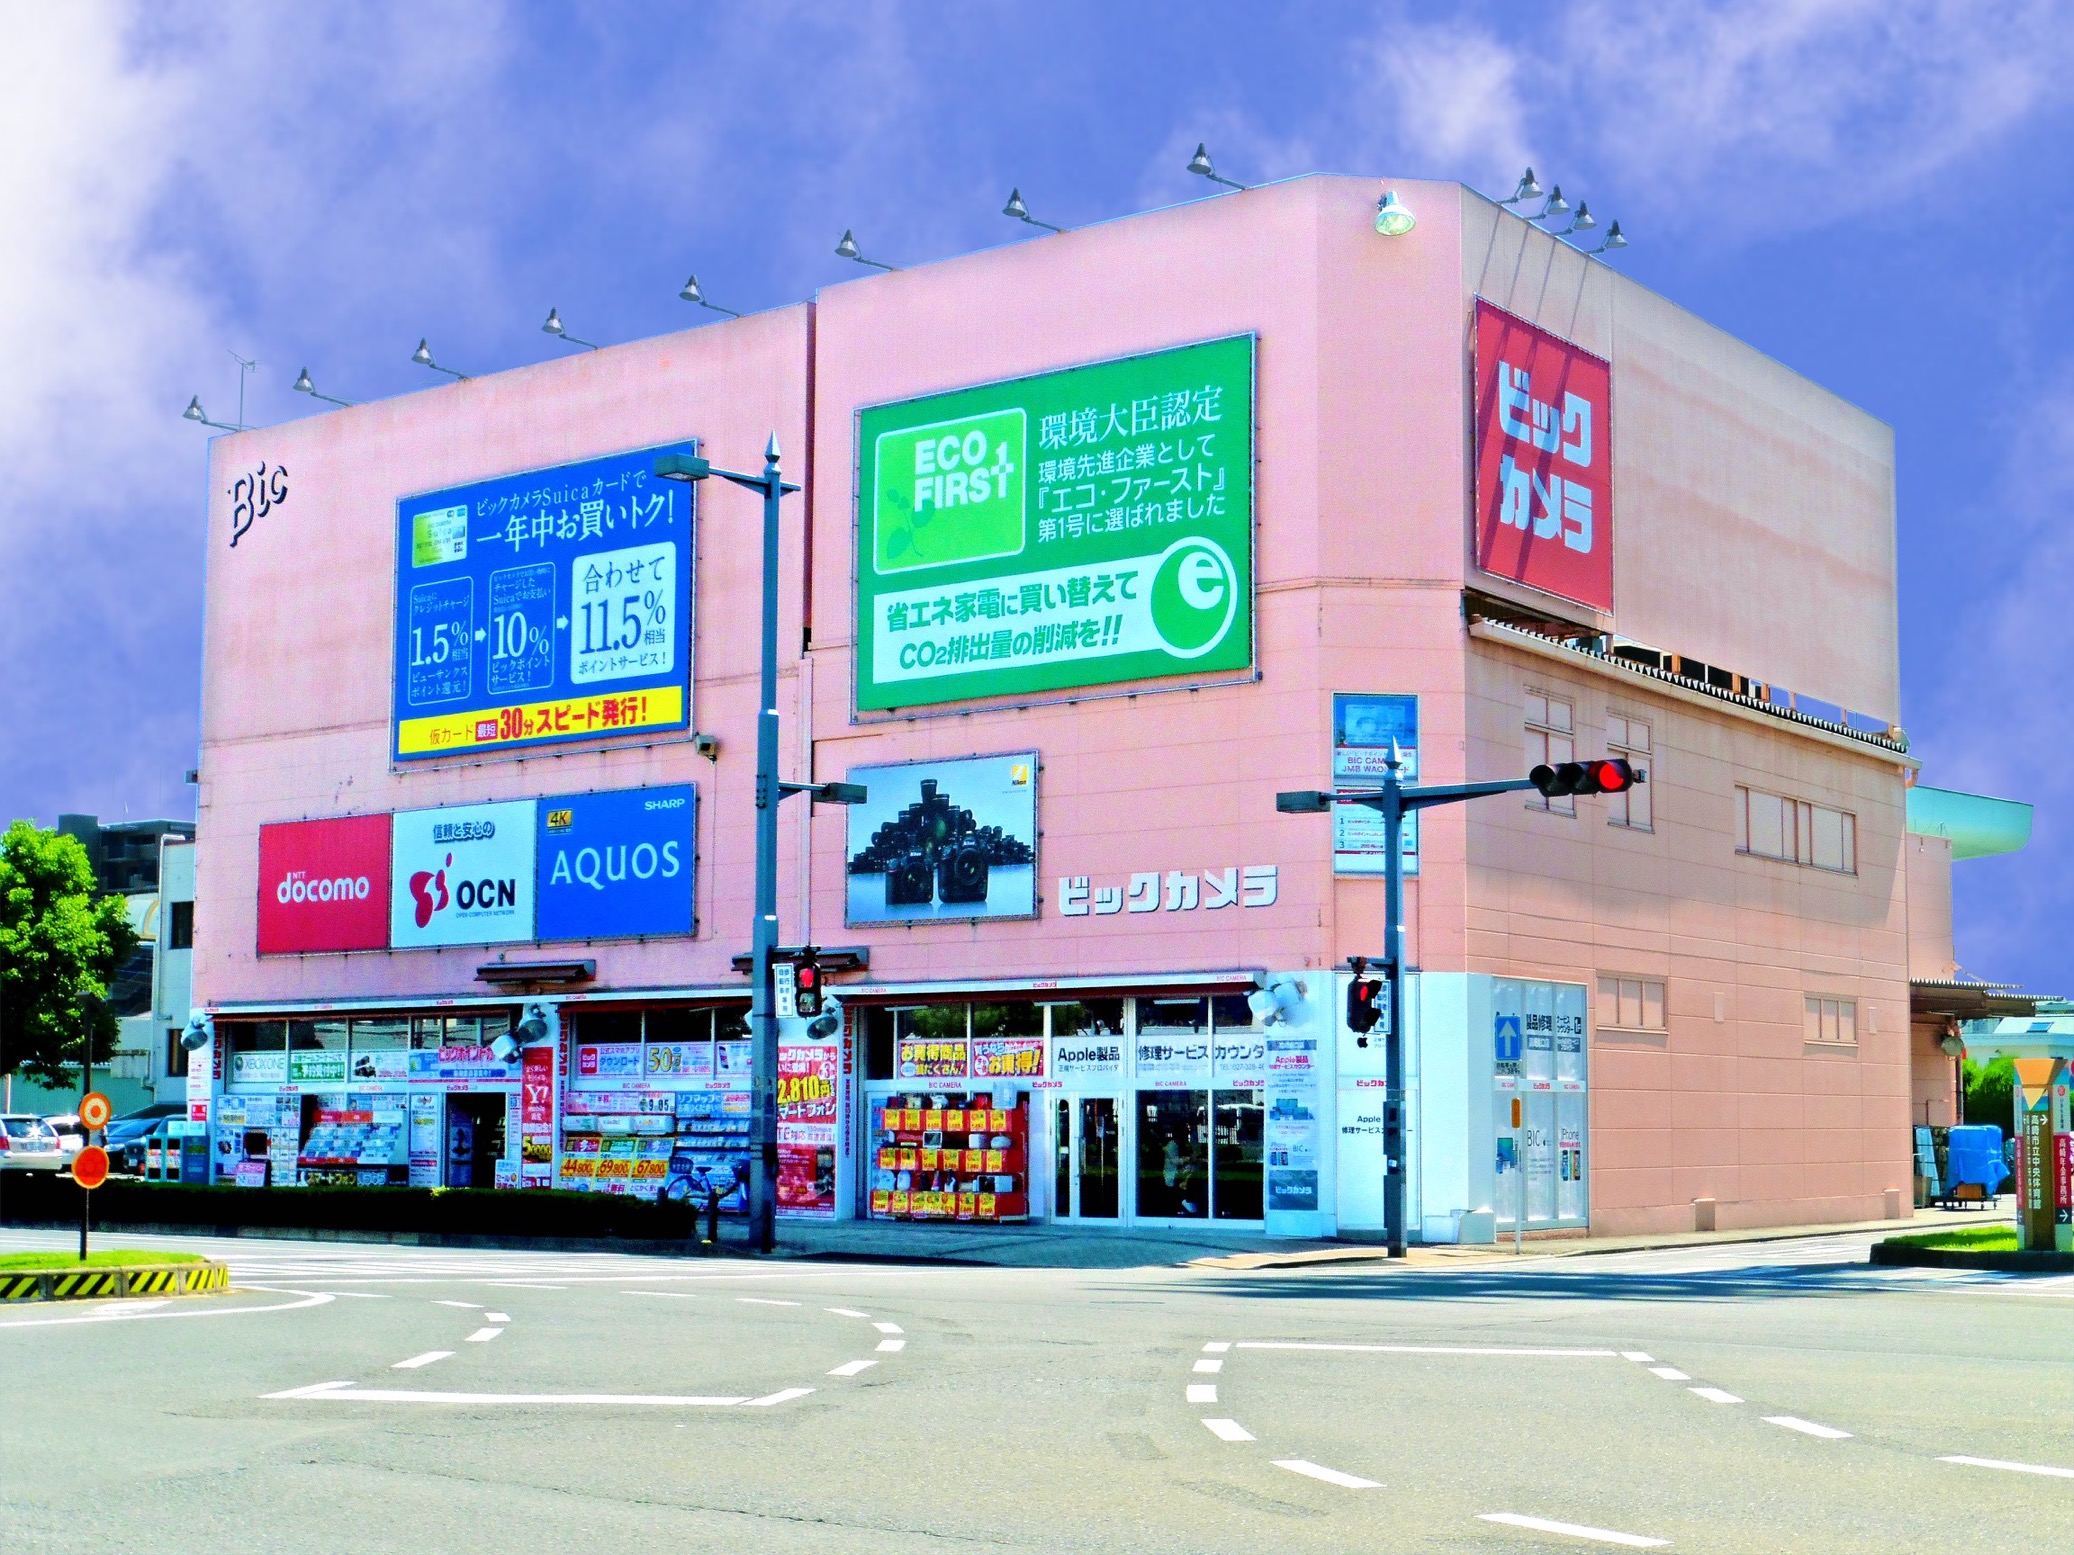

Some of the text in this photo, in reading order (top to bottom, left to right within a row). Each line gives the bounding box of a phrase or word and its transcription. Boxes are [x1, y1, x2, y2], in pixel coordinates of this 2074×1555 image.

[1039, 383, 1224, 450] 環境大臣認定
[1498, 359, 1593, 468] ビック
[914, 429, 988, 475] ECO
[1038, 433, 1216, 485] 環境先進企業として
[1038, 492, 1226, 544] 第1号に選ばれました
[1499, 453, 1593, 555] カメラ
[583, 556, 667, 595] 合わせて
[886, 569, 1140, 633] 省エネ家電に買い替えて
[492, 612, 550, 660] 10%
[643, 629, 666, 645] 相当
[429, 722, 473, 746] 仮カード
[550, 811, 567, 826] 4K
[644, 798, 686, 811] SHARP
[433, 822, 495, 844] 信頼と安心の
[292, 871, 306, 879] NTT
[549, 840, 681, 890] AQUOS
[276, 872, 370, 904] docomo
[456, 878, 515, 910] OCN
[1058, 864, 1279, 917] ビックカメラ
[1057, 1046, 1120, 1063] Apple製品
[1138, 1045, 1209, 1061] 修理サービス
[525, 1084, 550, 1104] Y!
[779, 1102, 836, 1120] マートフォン
[1356, 1115, 1381, 1123] Apple
[1527, 1130, 1541, 1147] BIC
